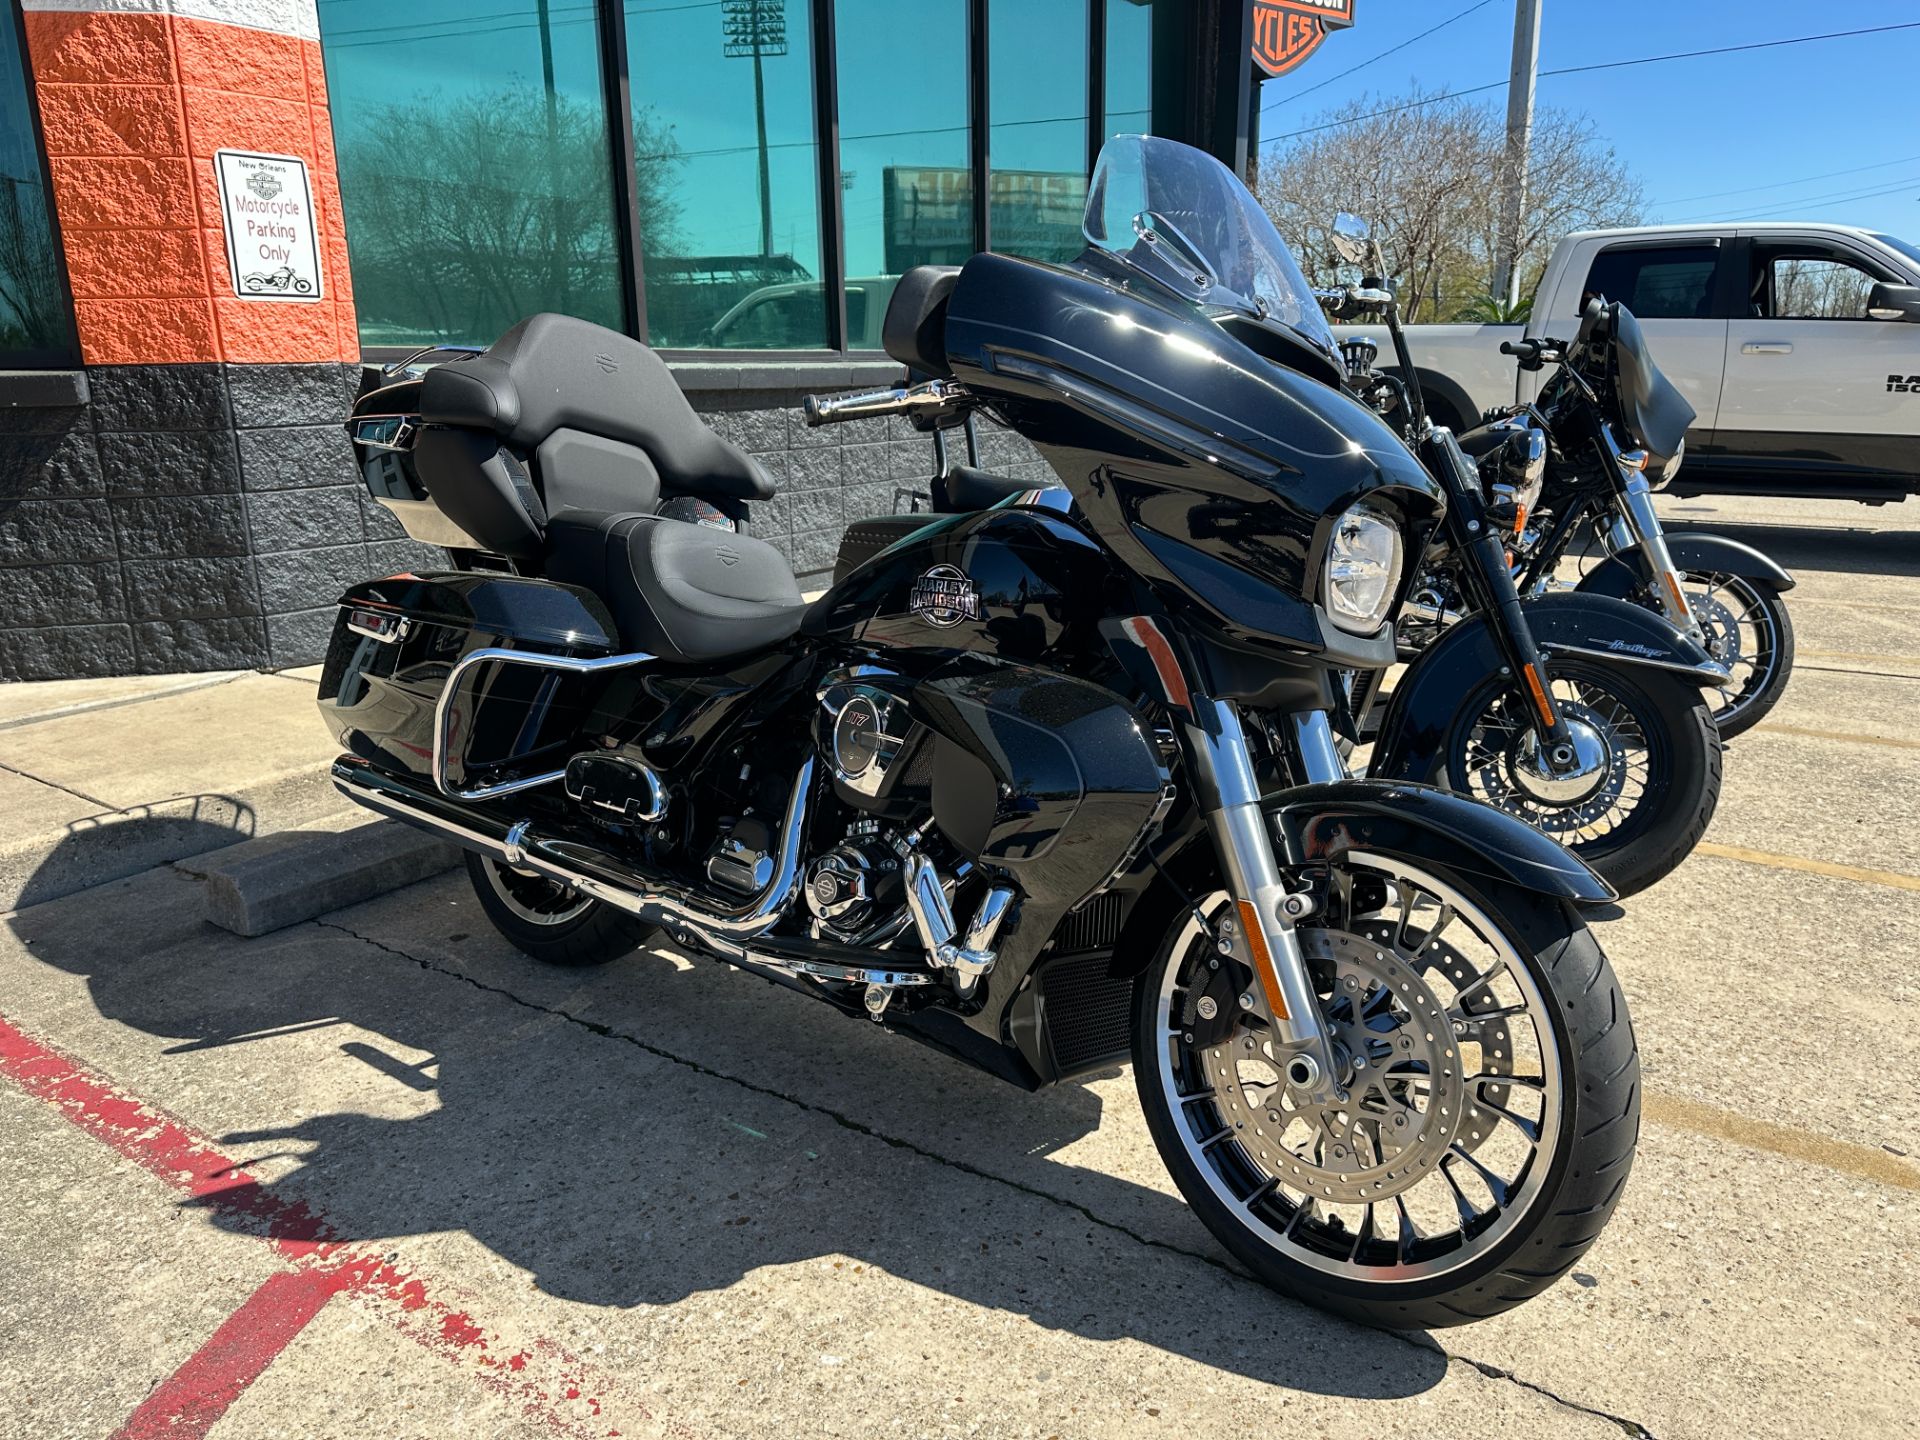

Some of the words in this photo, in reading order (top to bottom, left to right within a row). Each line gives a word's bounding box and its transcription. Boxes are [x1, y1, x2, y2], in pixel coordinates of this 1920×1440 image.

[239, 159, 256, 170] New
[258, 162, 287, 173] Orleans
[235, 195, 300, 219] Motorcycle
[247, 220, 296, 243] Parking
[259, 244, 291, 264] Only
[912, 591, 977, 615] DAVIDSON
[847, 711, 870, 726] 117
